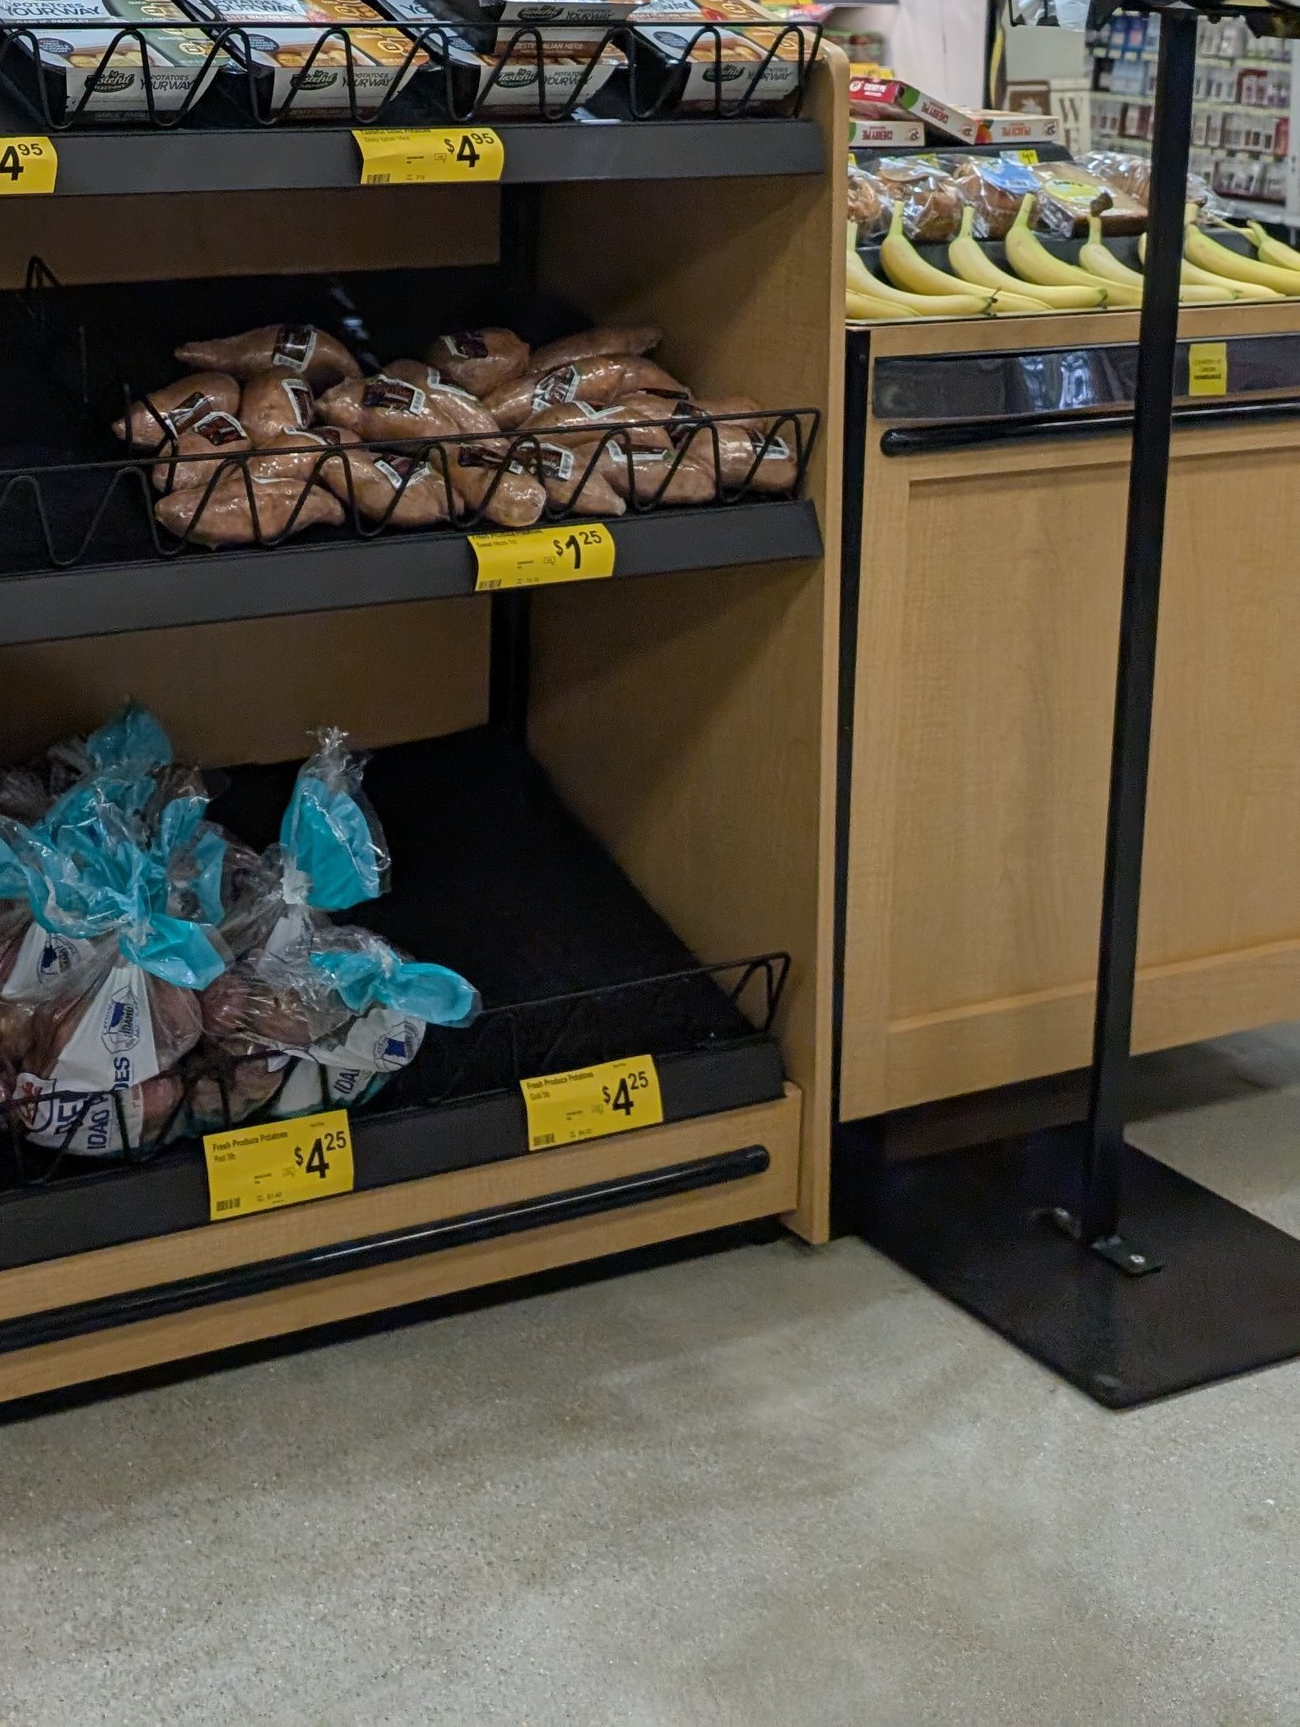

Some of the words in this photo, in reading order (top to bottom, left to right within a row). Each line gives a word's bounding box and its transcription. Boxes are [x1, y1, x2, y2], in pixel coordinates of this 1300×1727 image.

[527, 1081, 543, 1089] Fresh
[544, 1078, 567, 1086] Produce
[569, 1072, 594, 1081] Potatoes
[213, 1141, 231, 1152] Fresh
[232, 1137, 259, 1147] Produce
[260, 1131, 288, 1142] Potatoes
